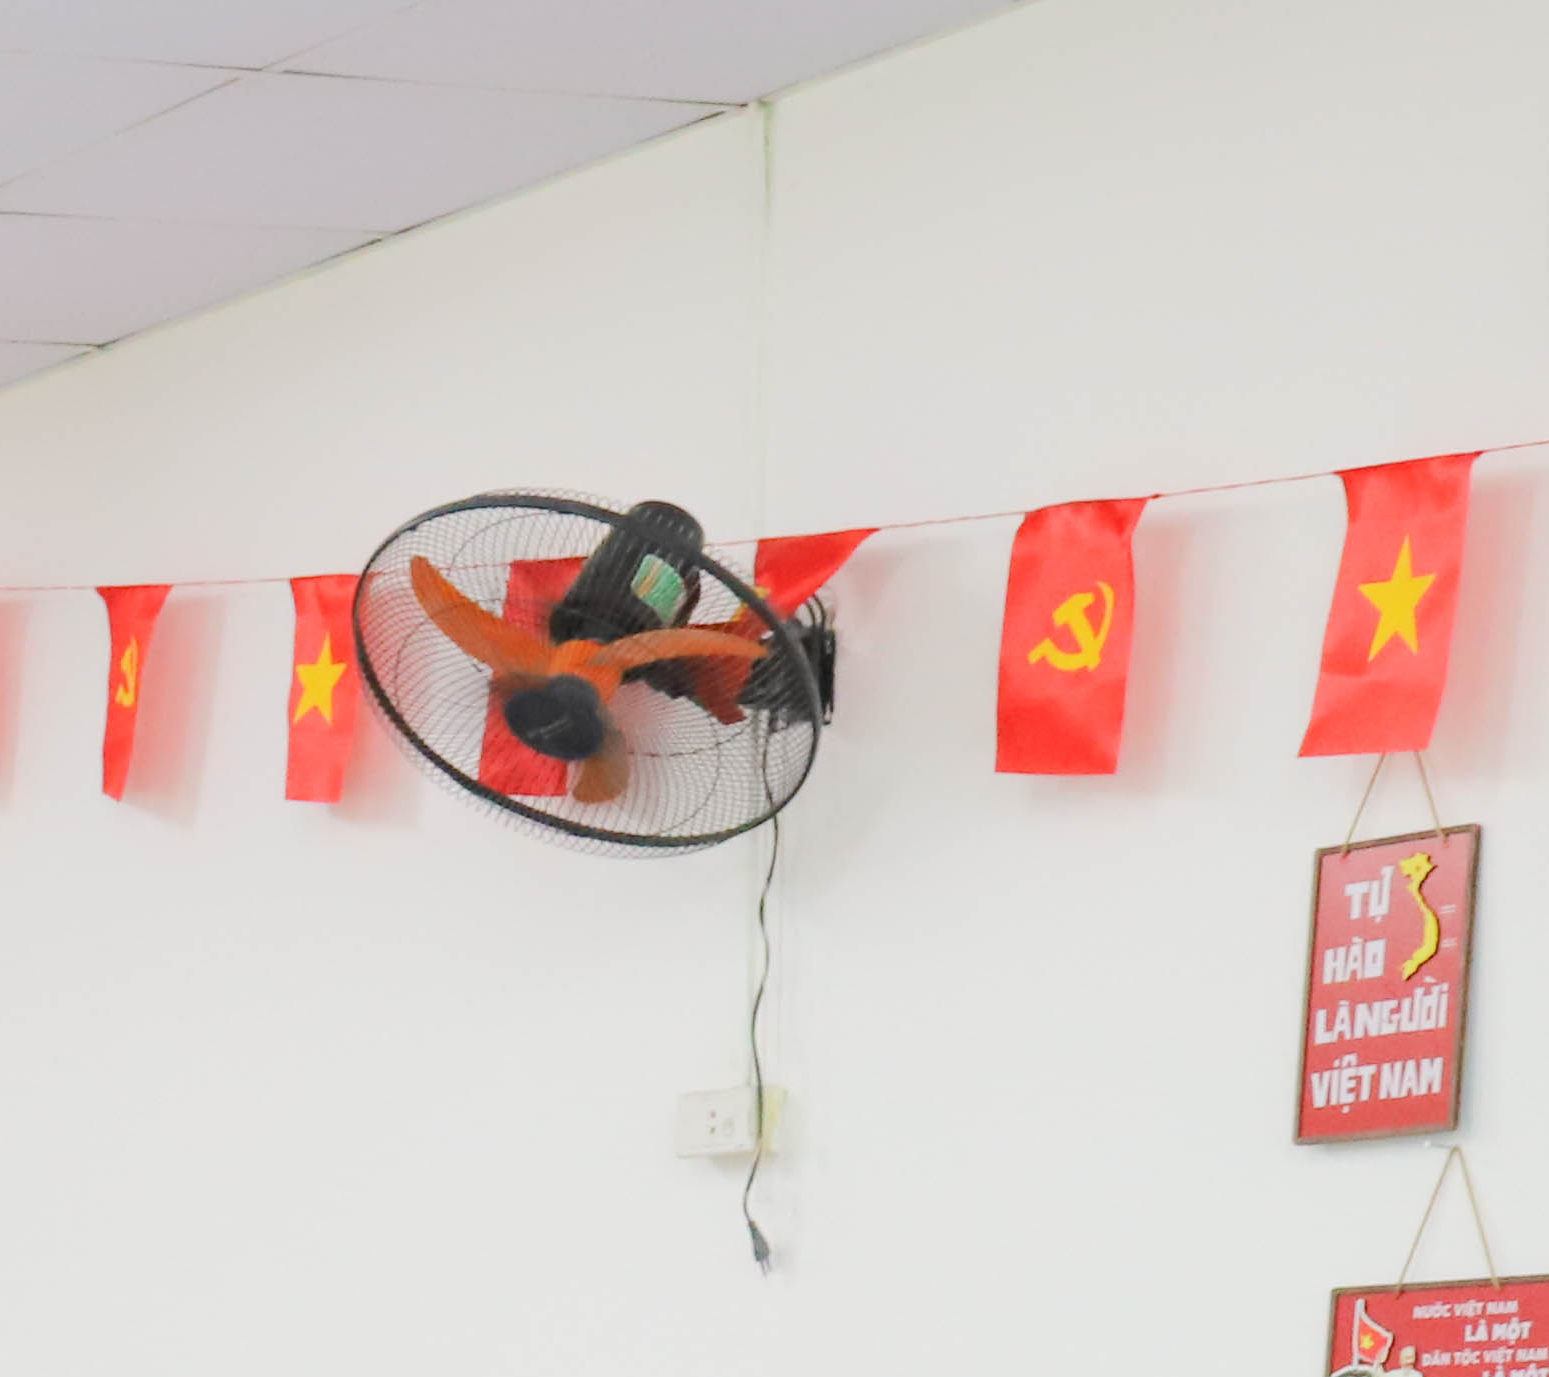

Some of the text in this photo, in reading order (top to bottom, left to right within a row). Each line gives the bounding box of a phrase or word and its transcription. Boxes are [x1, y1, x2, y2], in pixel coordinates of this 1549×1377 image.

[1344, 865, 1395, 923] TỰ
[1322, 936, 1386, 985] HÀO
[1311, 1053, 1444, 1114] VIỆT NAM
[1464, 1316, 1533, 1345] LÀ MỘT
